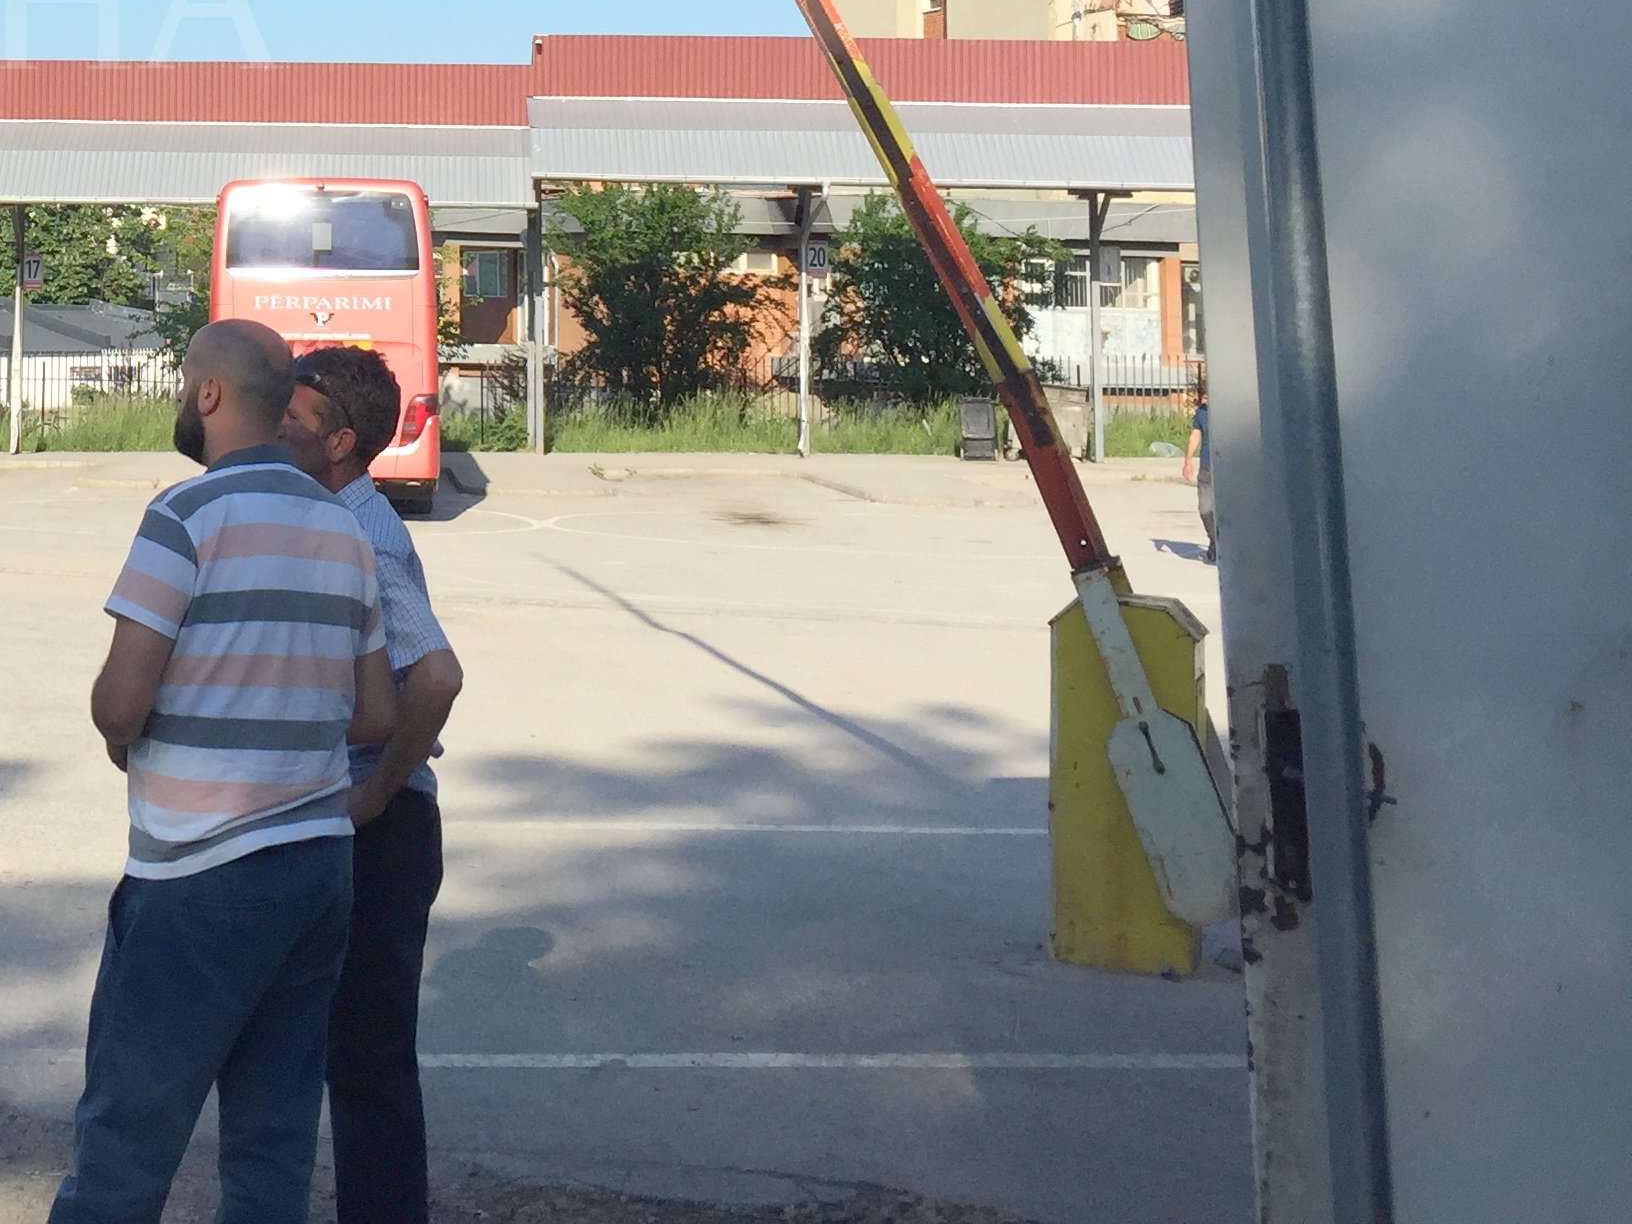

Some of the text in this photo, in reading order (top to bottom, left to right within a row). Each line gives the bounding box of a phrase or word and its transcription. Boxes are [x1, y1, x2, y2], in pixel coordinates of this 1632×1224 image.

[809, 247, 826, 267] 20
[26, 259, 41, 279] 17
[254, 293, 391, 310] PËRPARIMI
